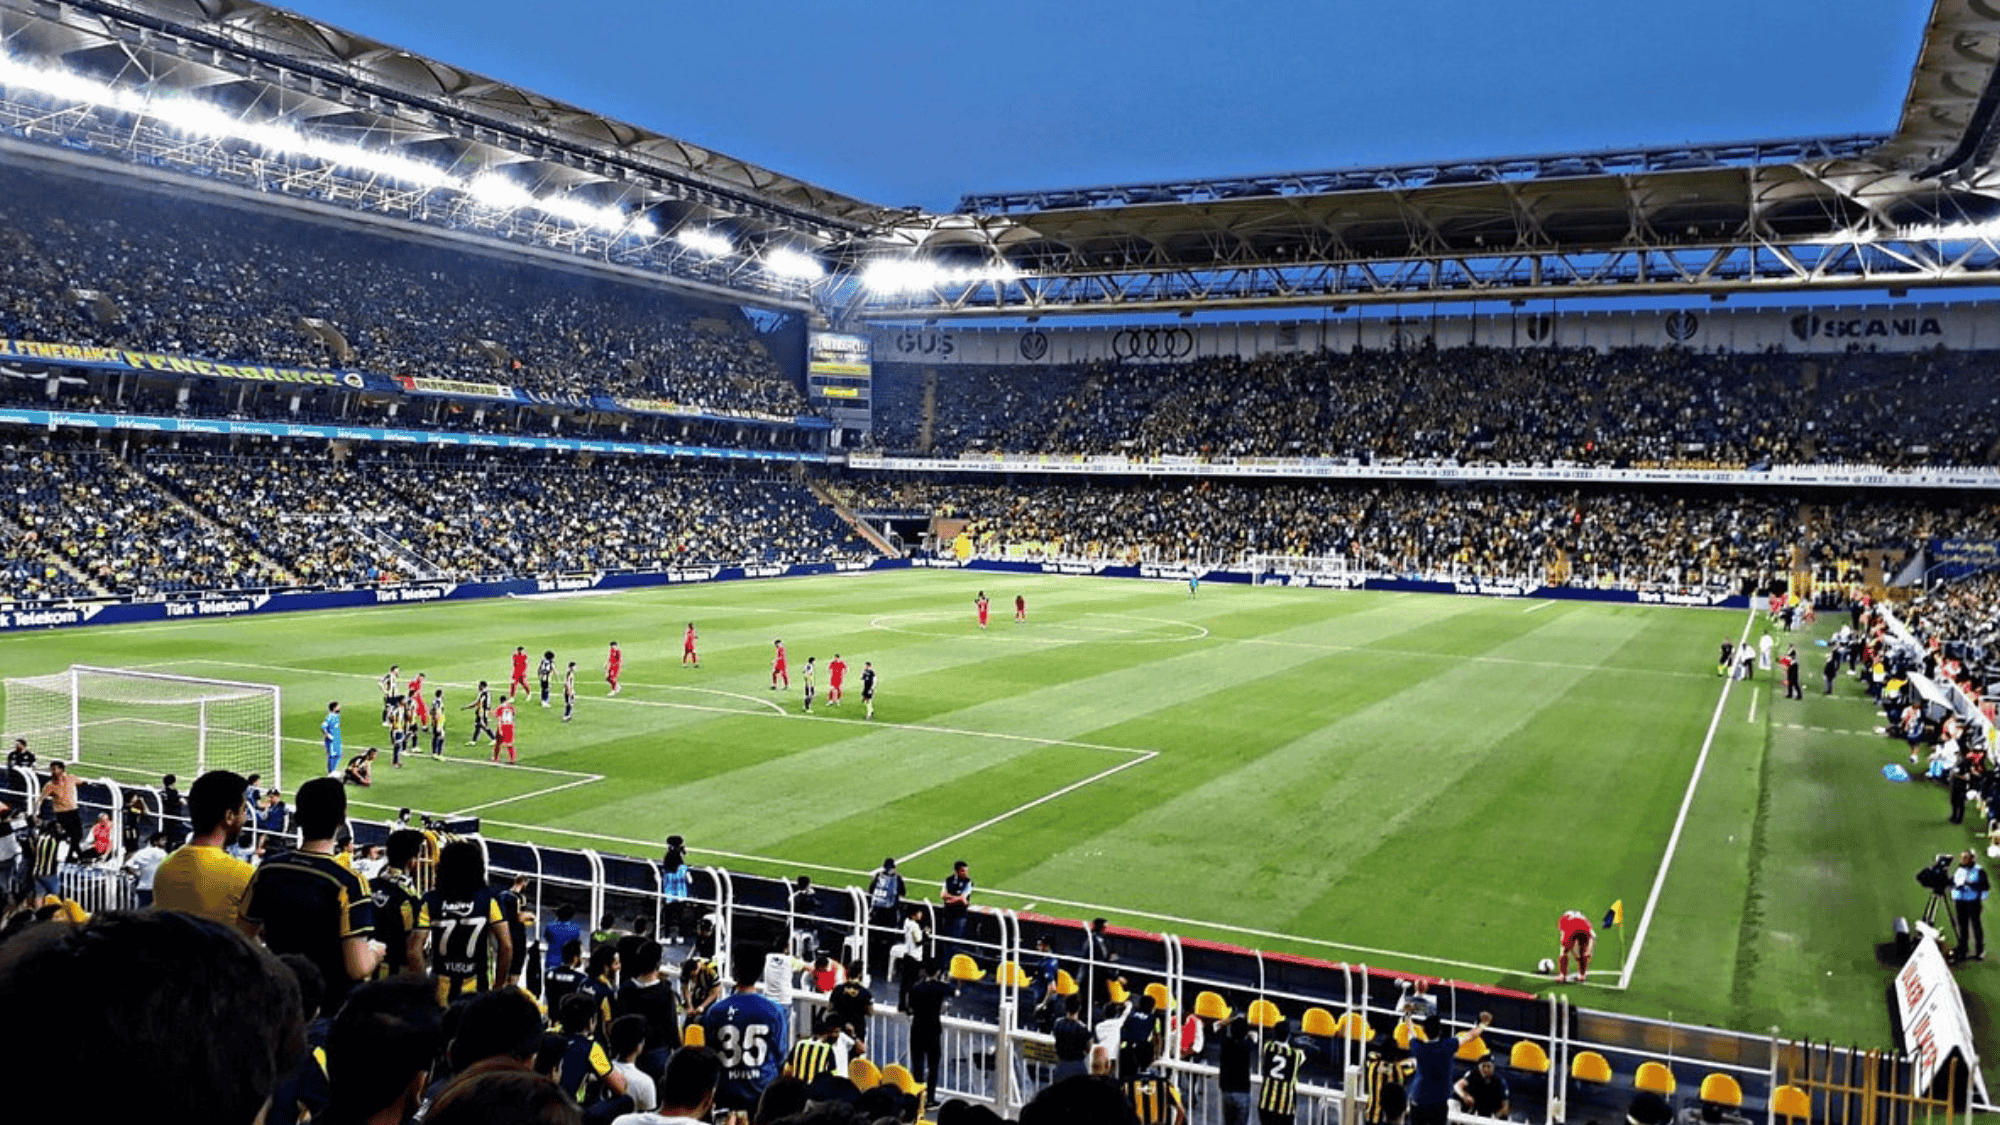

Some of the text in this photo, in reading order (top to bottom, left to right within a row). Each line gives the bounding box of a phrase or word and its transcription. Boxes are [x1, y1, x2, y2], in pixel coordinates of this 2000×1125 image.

[1824, 319, 1942, 338] SCANIA
[376, 587, 440, 602] Türk Telekom
[165, 600, 249, 616] Türk Telekom
[13, 611, 77, 626] Telekom
[430, 916, 487, 958] 77
[717, 1025, 769, 1068] 35
[1270, 1055, 1287, 1080] 2
